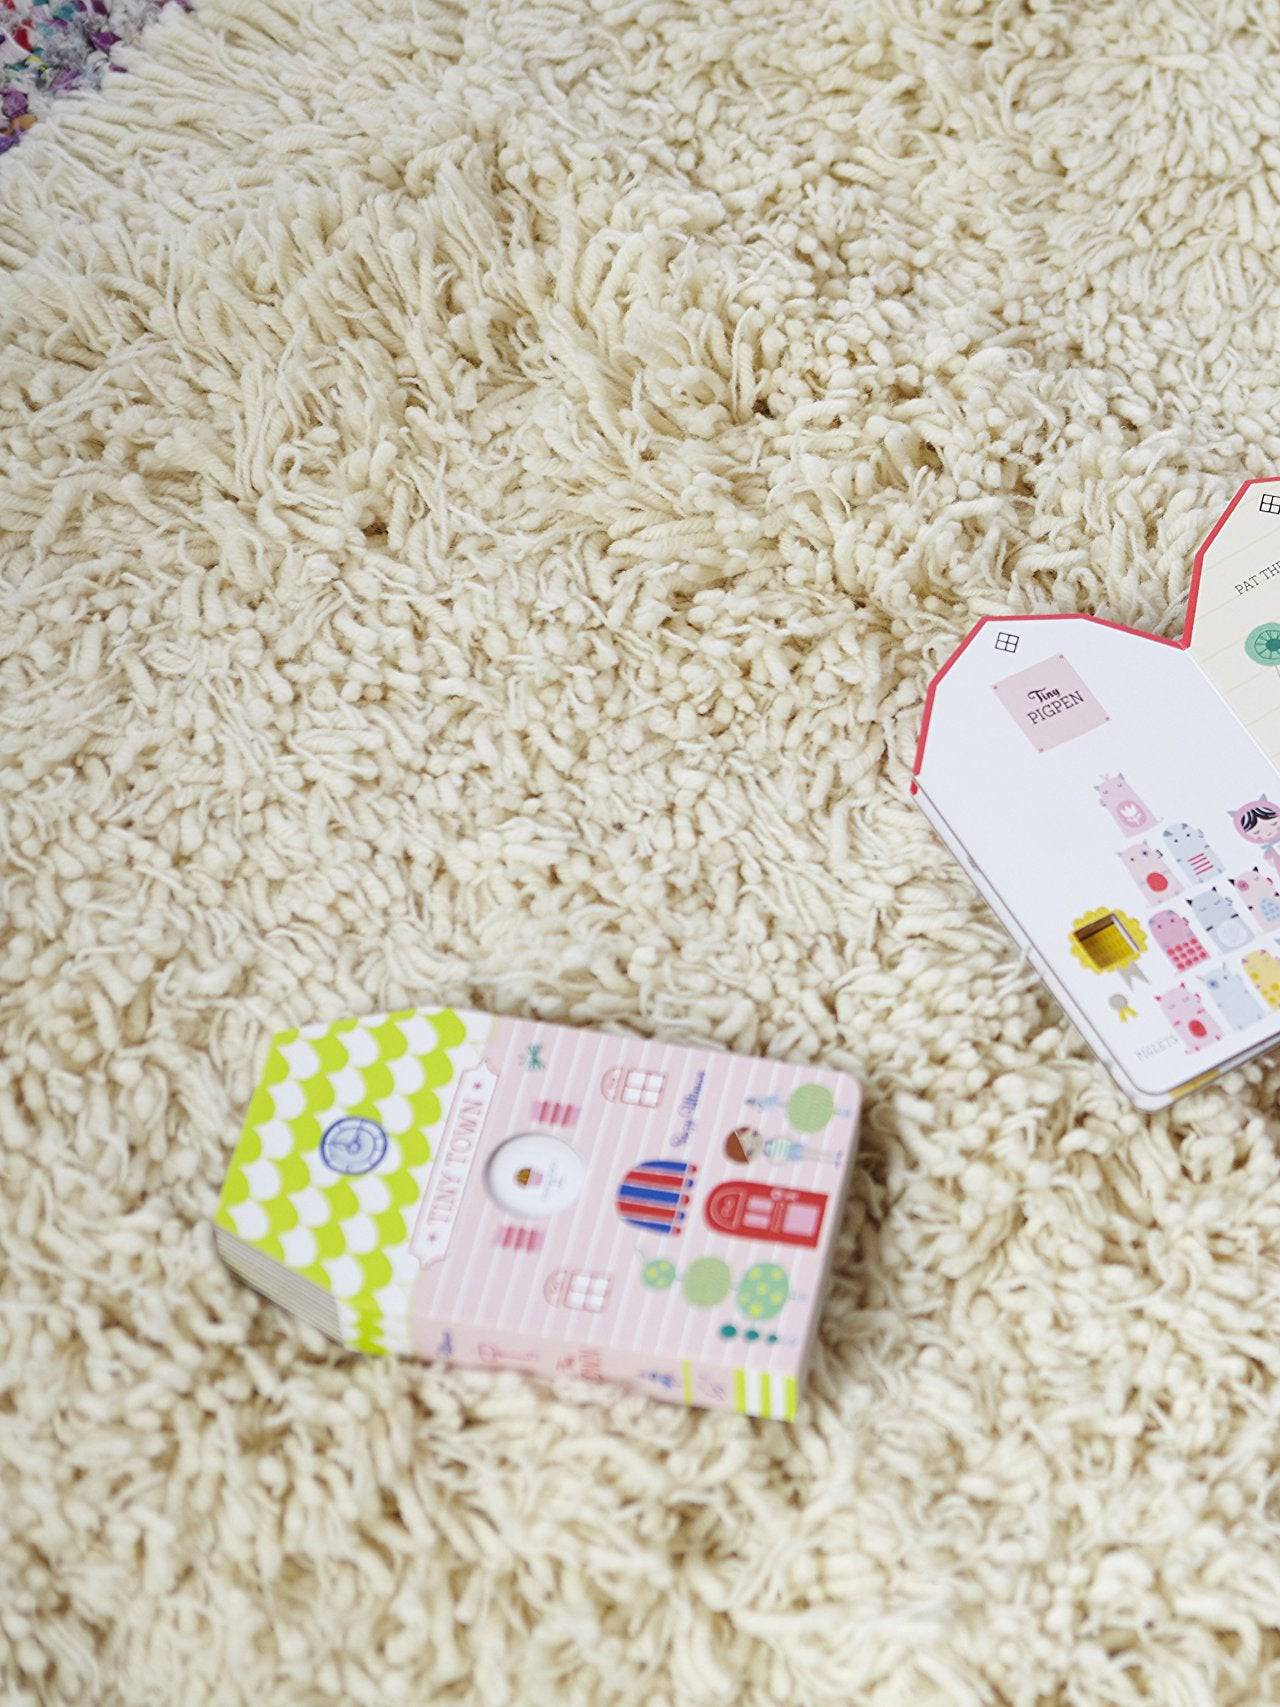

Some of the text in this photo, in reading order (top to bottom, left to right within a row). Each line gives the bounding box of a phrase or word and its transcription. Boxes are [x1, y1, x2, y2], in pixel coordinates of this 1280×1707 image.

[1234, 575, 1259, 595] PAT
[1027, 688, 1061, 702] Tiny
[1027, 690, 1084, 725] PIGPEN
[427, 1098, 483, 1226] TINY TOWN
